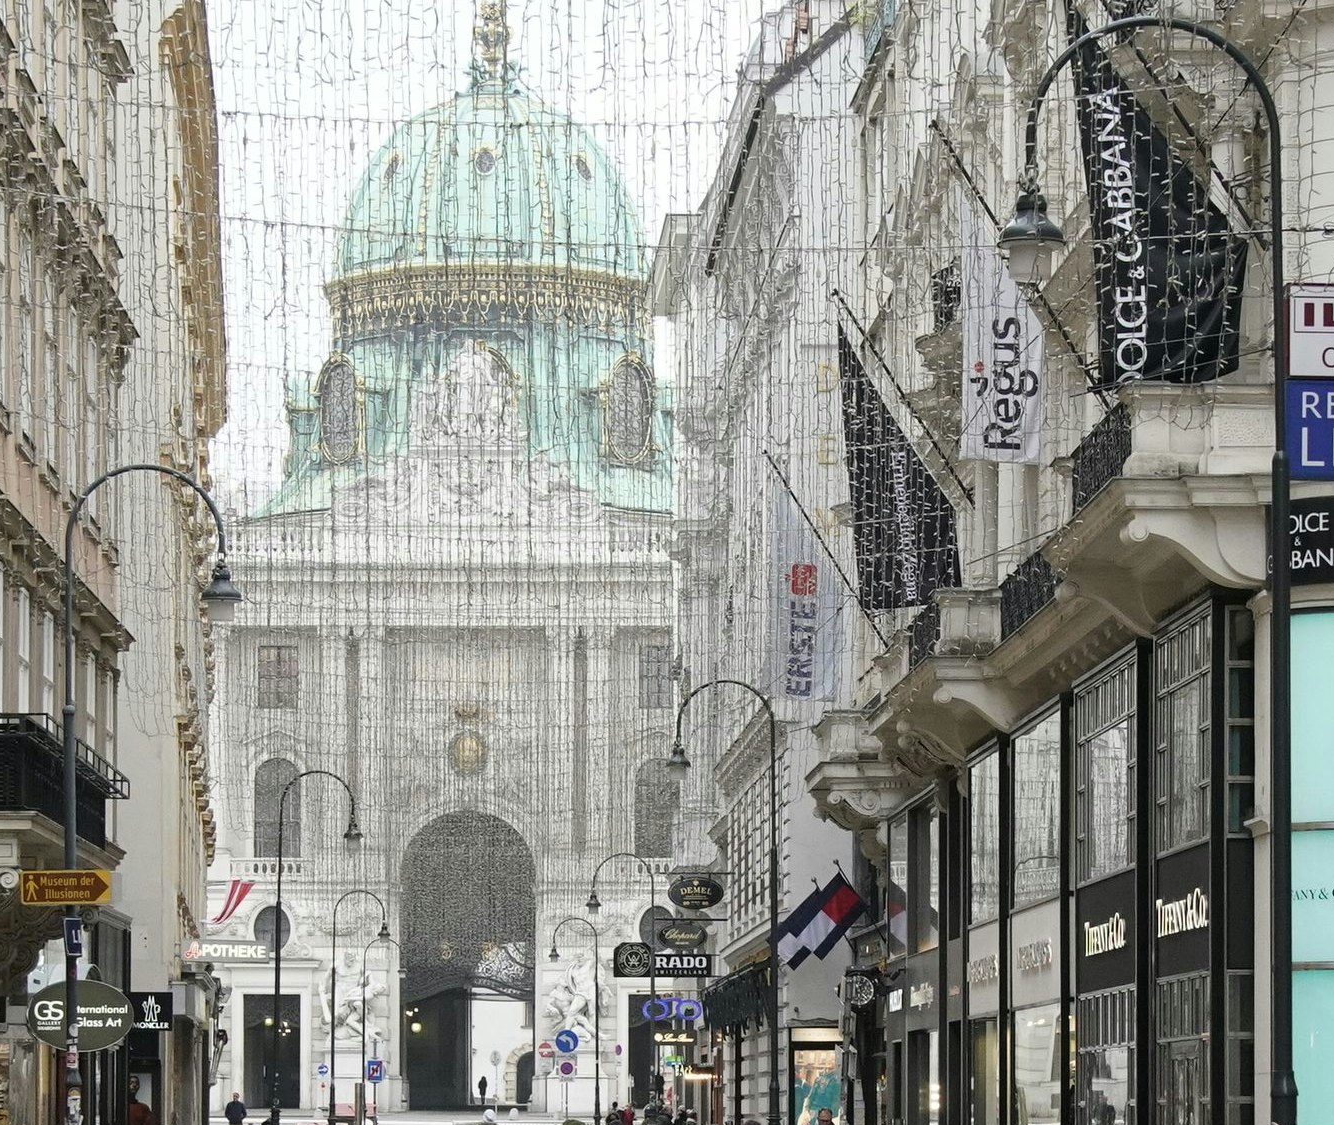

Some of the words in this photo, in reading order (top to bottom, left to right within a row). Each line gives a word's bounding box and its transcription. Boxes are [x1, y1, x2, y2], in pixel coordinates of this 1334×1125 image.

[983, 315, 1038, 451] Regus
[1289, 512, 1330, 535] OLCE
[1294, 536, 1302, 547] &
[786, 602, 818, 697] ERSTE
[40, 876, 78, 887] Museum
[80, 876, 95, 886] der
[45, 889, 91, 899] Illusionen
[679, 886, 712, 896] DEMEL
[1318, 888, 1329, 901] &
[664, 928, 702, 940] Chopard
[184, 941, 267, 959] APOTHEKE
[655, 956, 707, 968] RADO
[34, 1000, 64, 1021] GS
[76, 1004, 128, 1014] ternational
[105, 1018, 122, 1028] Art
